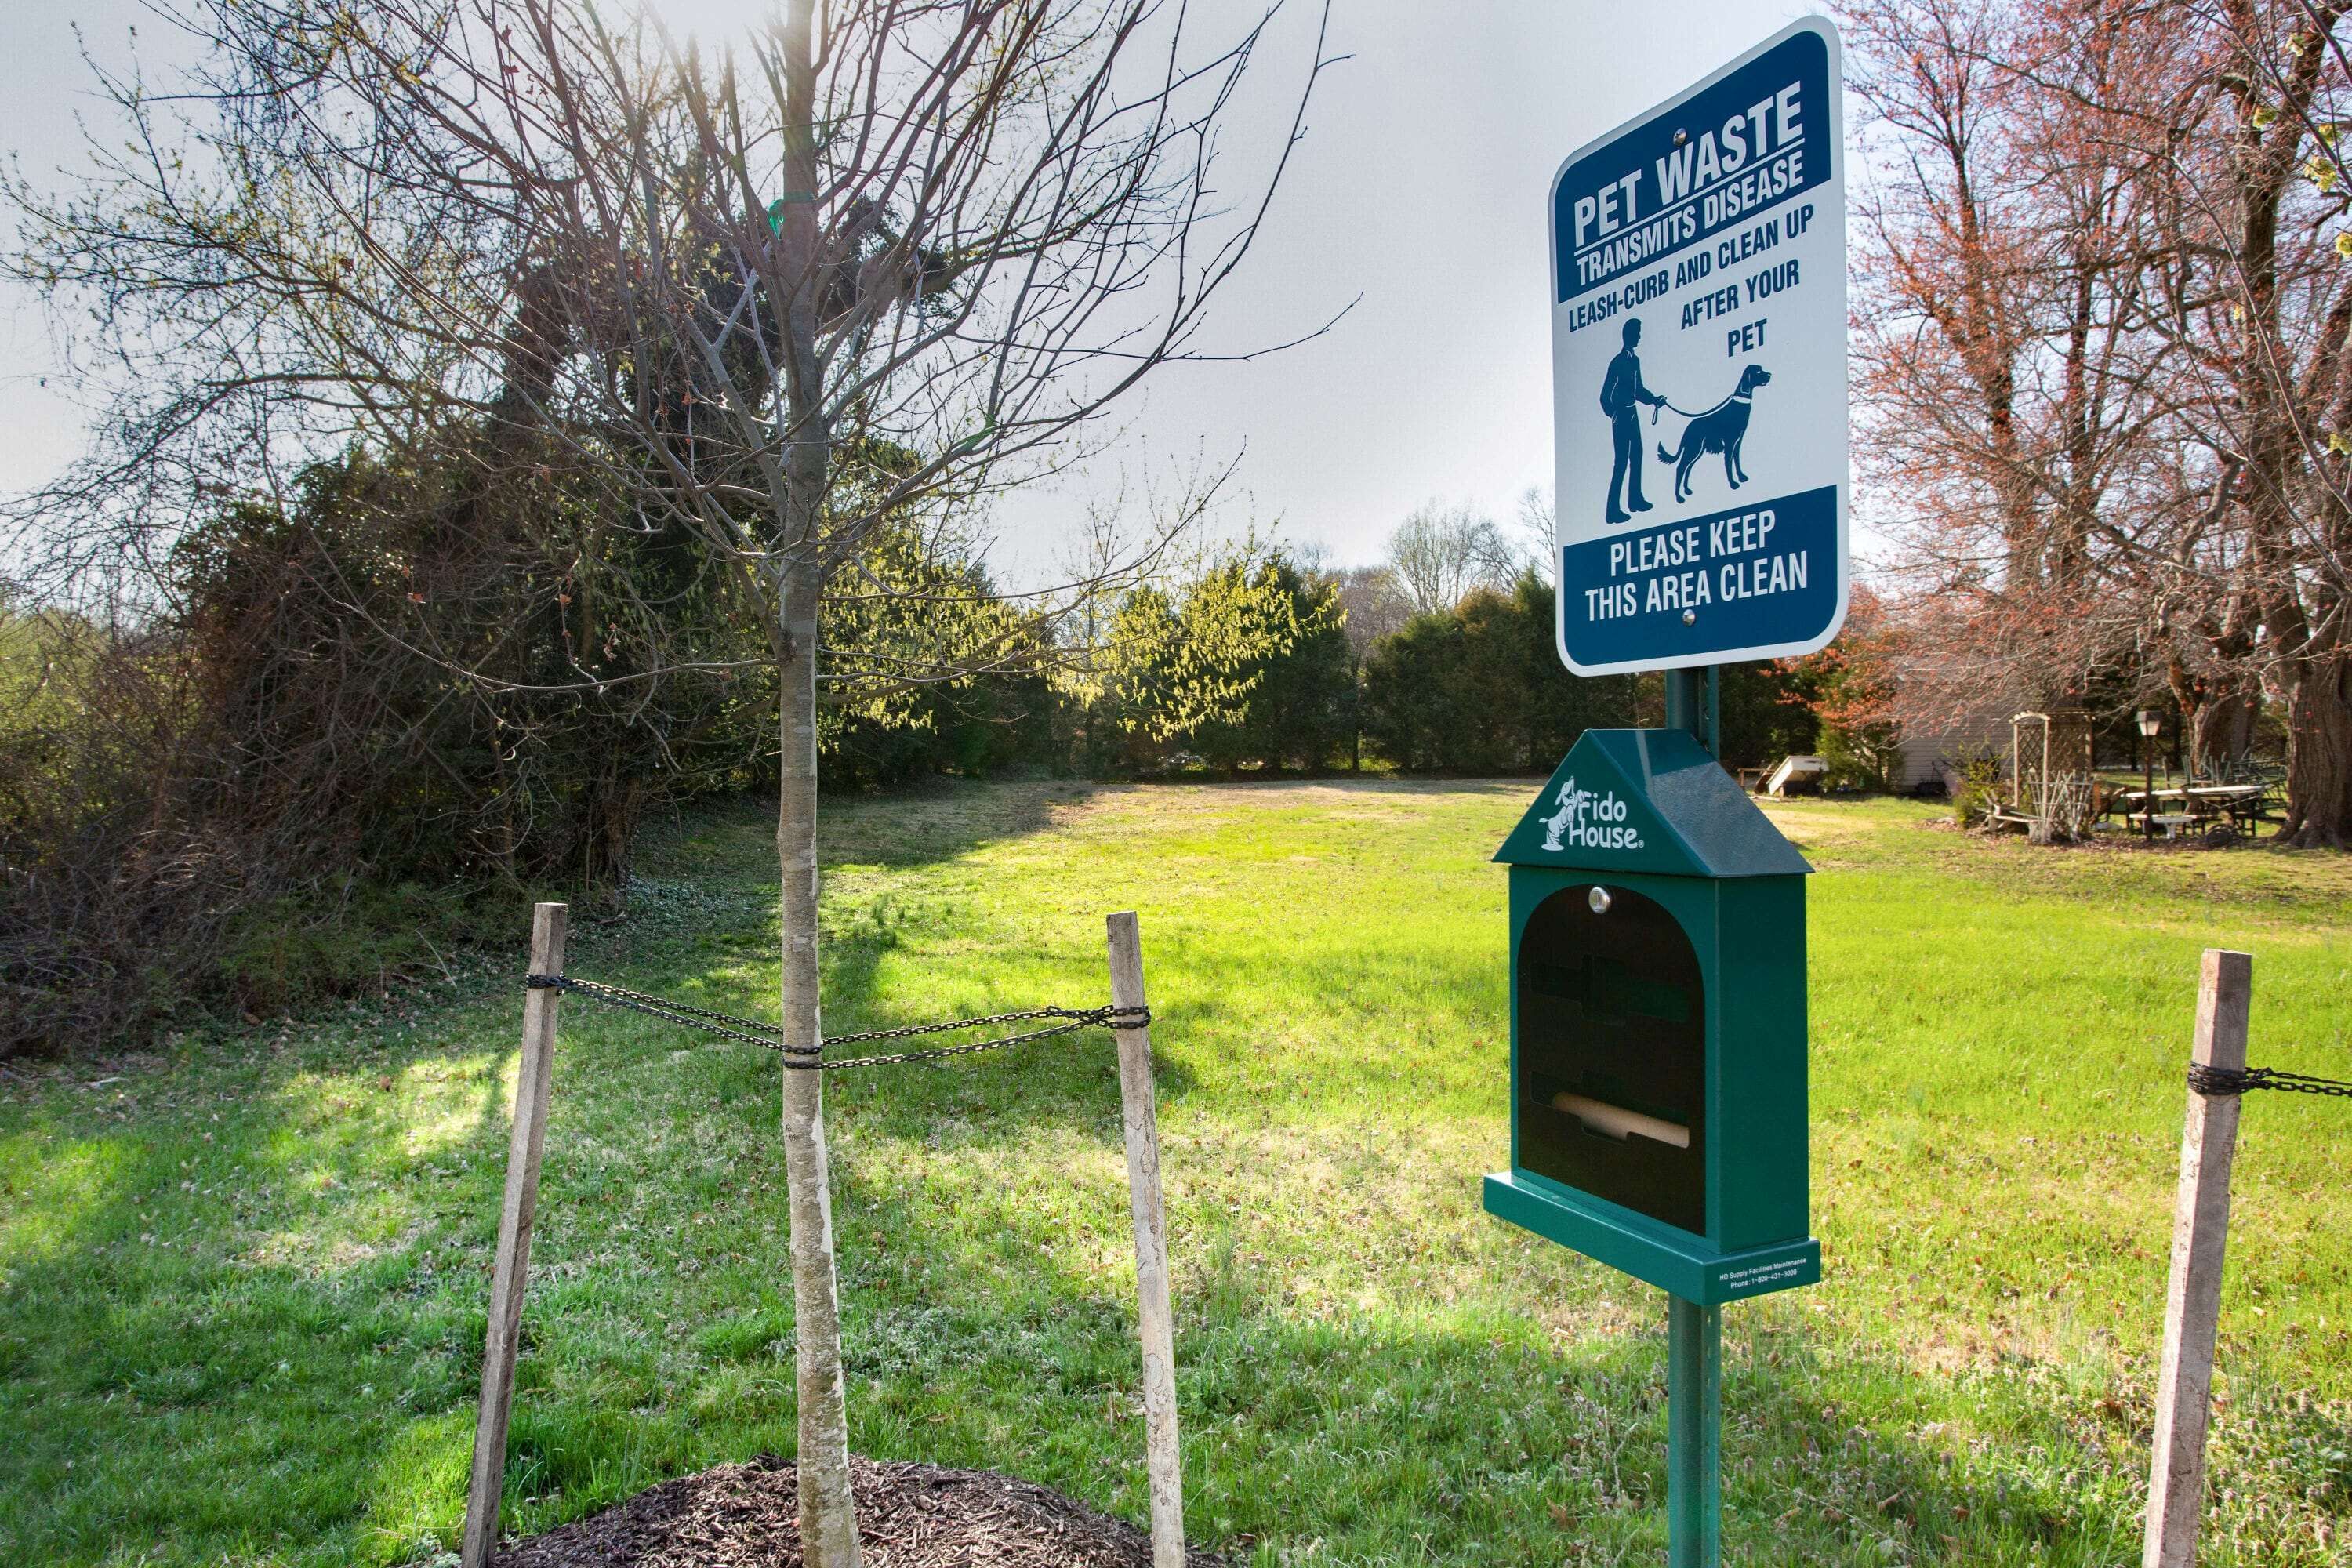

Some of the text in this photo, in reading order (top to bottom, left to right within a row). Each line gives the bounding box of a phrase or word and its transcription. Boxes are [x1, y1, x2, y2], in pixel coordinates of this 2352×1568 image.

[1574, 80, 1803, 249] PET WASTE
[1577, 150, 1803, 287] TRANSMITS DISEASE
[1569, 203, 1814, 333] LEASH-CURB AND CLEAN UP
[1681, 258, 1800, 330] AFTER YOUR
[1728, 318, 1767, 358] PET
[1610, 510, 1776, 577] PLEASE KEEP
[1585, 550, 1807, 622] THIS AREA CLEAN
[1578, 790, 1627, 822] Fido
[1730, 1270, 1748, 1279] Supply
[1748, 1265, 1773, 1275] Facilities
[1773, 1258, 1806, 1269] Maintenance
[1730, 1269, 1797, 1289] Phone: 1-800-431-3000
